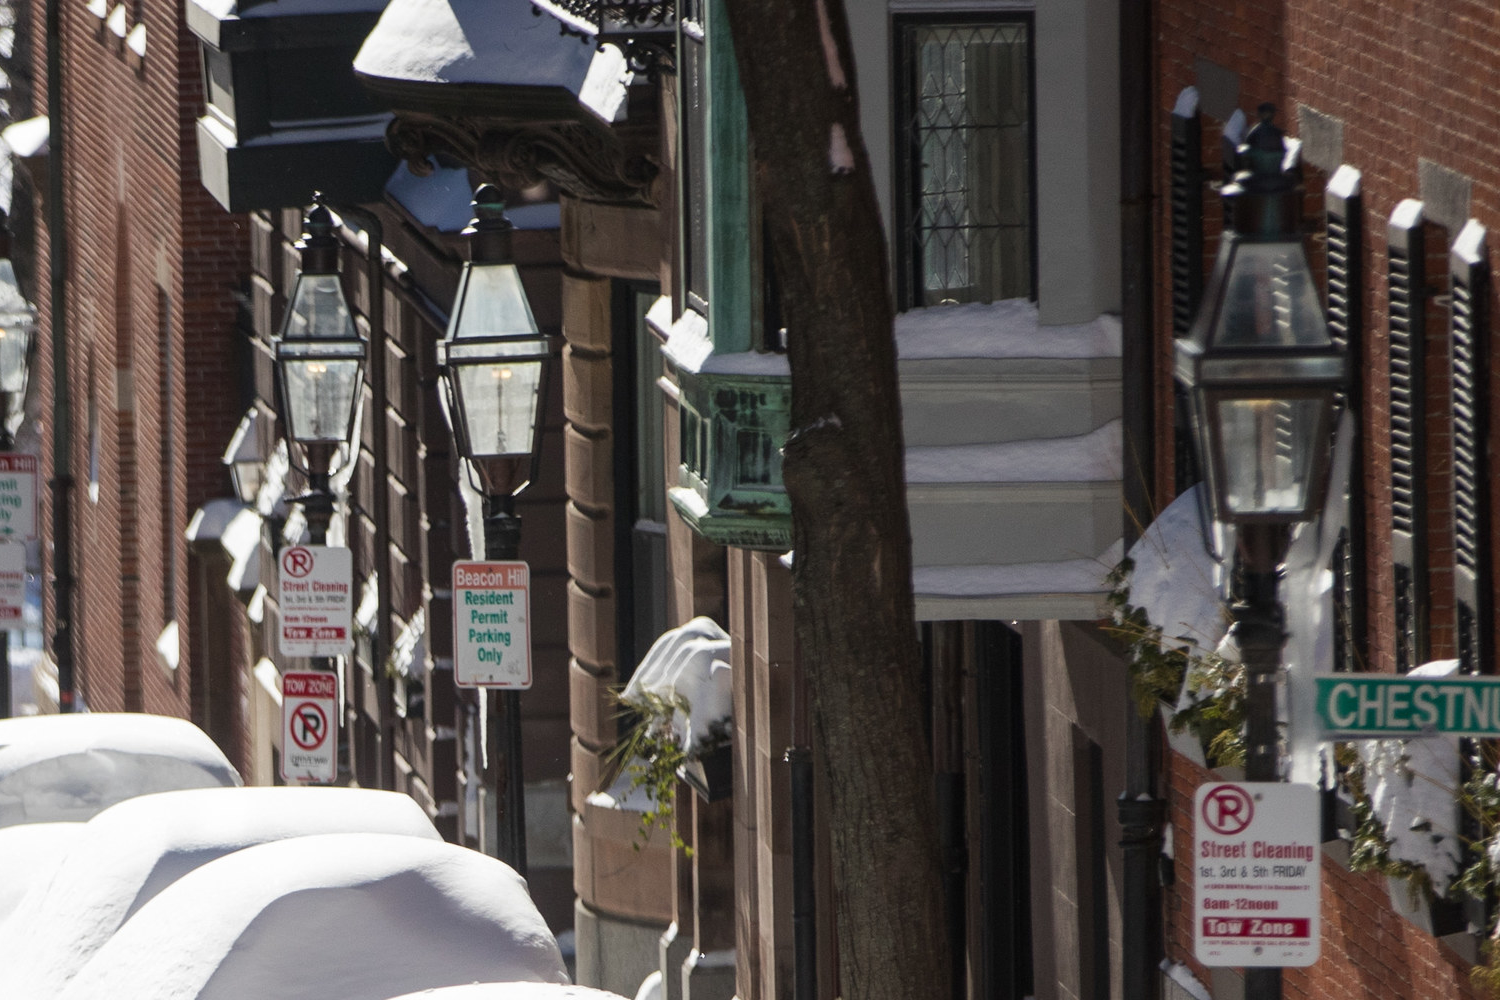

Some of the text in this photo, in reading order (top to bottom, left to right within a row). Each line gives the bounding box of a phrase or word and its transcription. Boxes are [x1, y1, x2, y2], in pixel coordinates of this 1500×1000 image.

[14, 457, 35, 469] Hill
[456, 568, 527, 586] Beacon Hill
[282, 581, 349, 594] Street Cleaning
[465, 590, 514, 605] Resident
[471, 609, 509, 624] Permit
[287, 628, 308, 639] Tow
[468, 629, 512, 647] Parking
[477, 647, 503, 665] Only
[286, 679, 334, 694] TOW ZONE
[1201, 841, 1313, 862] Street Cleaning
[1220, 865, 1237, 877] 3rd
[1241, 866, 1248, 877] &
[1253, 866, 1269, 877] 5th
[1272, 866, 1306, 877] FRIDAY
[1203, 898, 1279, 910] 8am-12noon
[1207, 919, 1295, 935] Tow Zone
